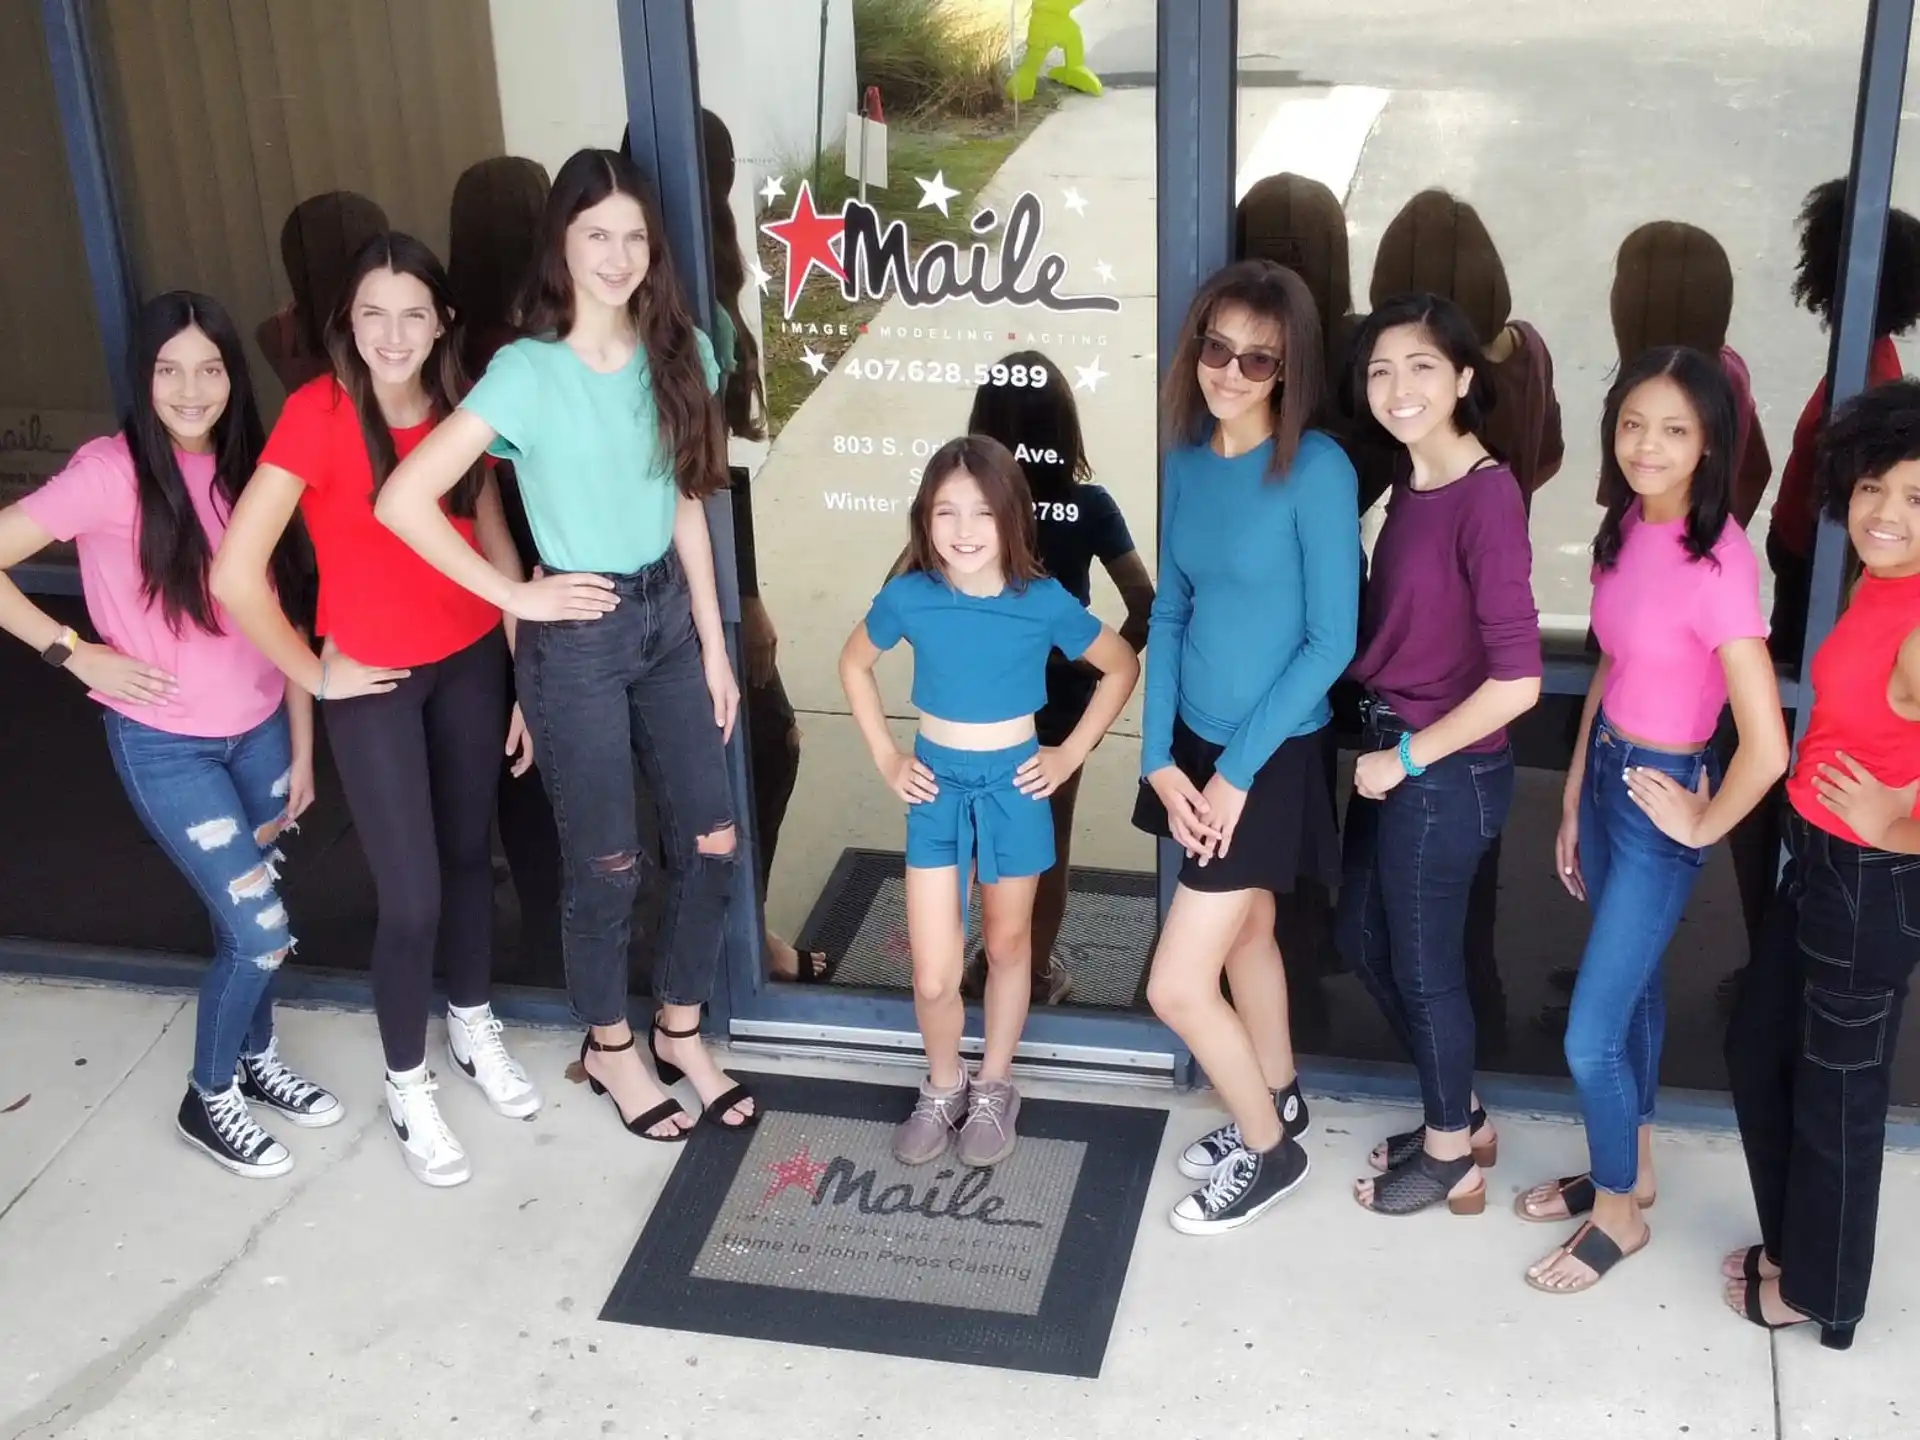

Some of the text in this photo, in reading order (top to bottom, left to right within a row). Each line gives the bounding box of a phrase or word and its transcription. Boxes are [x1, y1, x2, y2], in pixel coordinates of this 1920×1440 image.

[841, 190, 1121, 312] Maile
[781, 322, 1108, 346] IMAGE MODELING ACTING
[844, 357, 1049, 389] 407.628.5989
[832, 435, 874, 455] 803
[881, 437, 904, 456] S.
[1014, 443, 1065, 465] Ave.
[823, 491, 900, 513] Winter
[811, 1156, 1043, 1229] Maile
[722, 1232, 1032, 1283] Home to John Peros Casting
